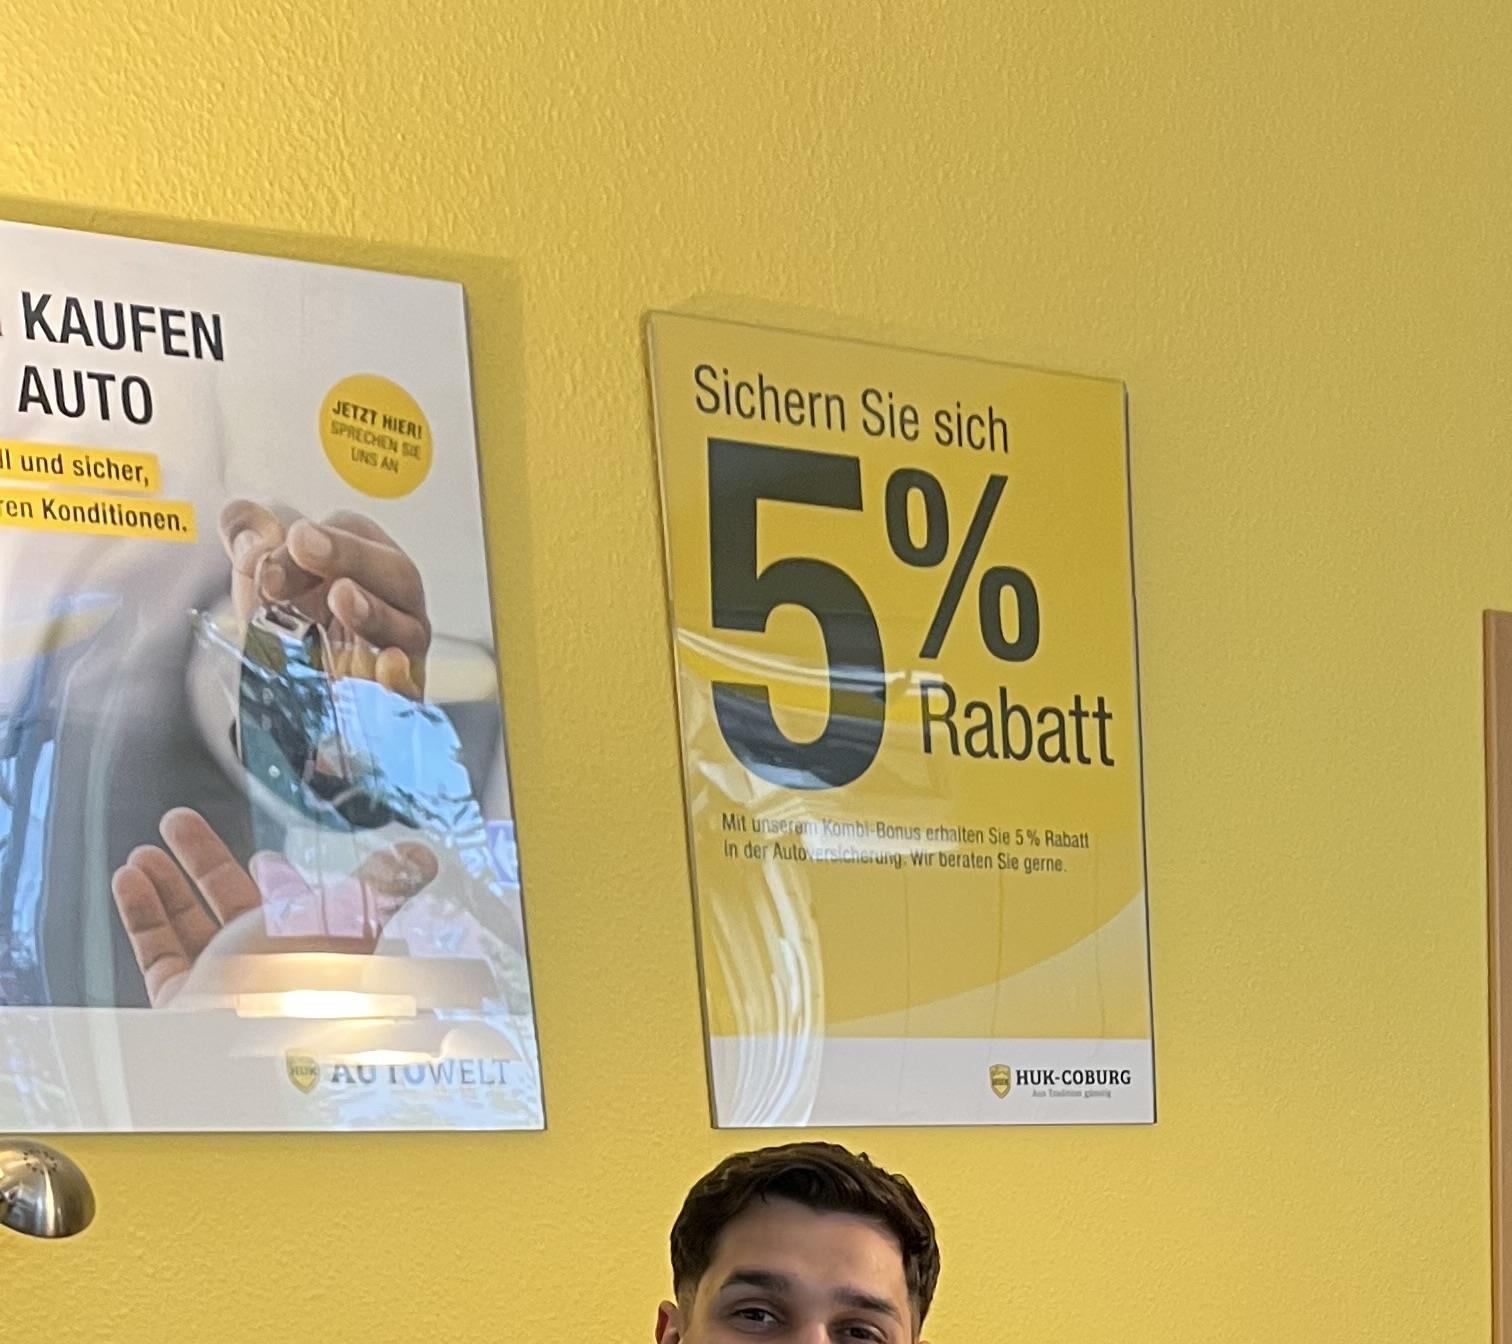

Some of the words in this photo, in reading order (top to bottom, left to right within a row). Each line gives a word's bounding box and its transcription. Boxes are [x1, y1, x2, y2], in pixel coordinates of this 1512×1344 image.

[21, 290, 225, 362] KAUFEN
[18, 364, 154, 426] AUTO
[694, 364, 846, 432] Sichern
[862, 388, 919, 441] Sie
[934, 401, 1009, 454] sich
[332, 400, 378, 425] JETZT
[21, 453, 64, 475] und
[72, 455, 150, 487] sicher,
[381, 456, 399, 474] AN
[41, 498, 187, 532] Konditionen.
[919, 679, 1115, 767] Rabatt
[722, 813, 746, 832] Mit
[926, 825, 983, 844] erhalten
[988, 827, 1010, 845] Sie
[1045, 829, 1089, 849] Rabatt
[744, 842, 768, 860] der
[910, 850, 934, 867] Wir
[939, 852, 993, 869] beraten
[997, 852, 1019, 870] Sie
[1024, 856, 1067, 875] gerne.
[1016, 1069, 1131, 1086] HUK-COBURG
